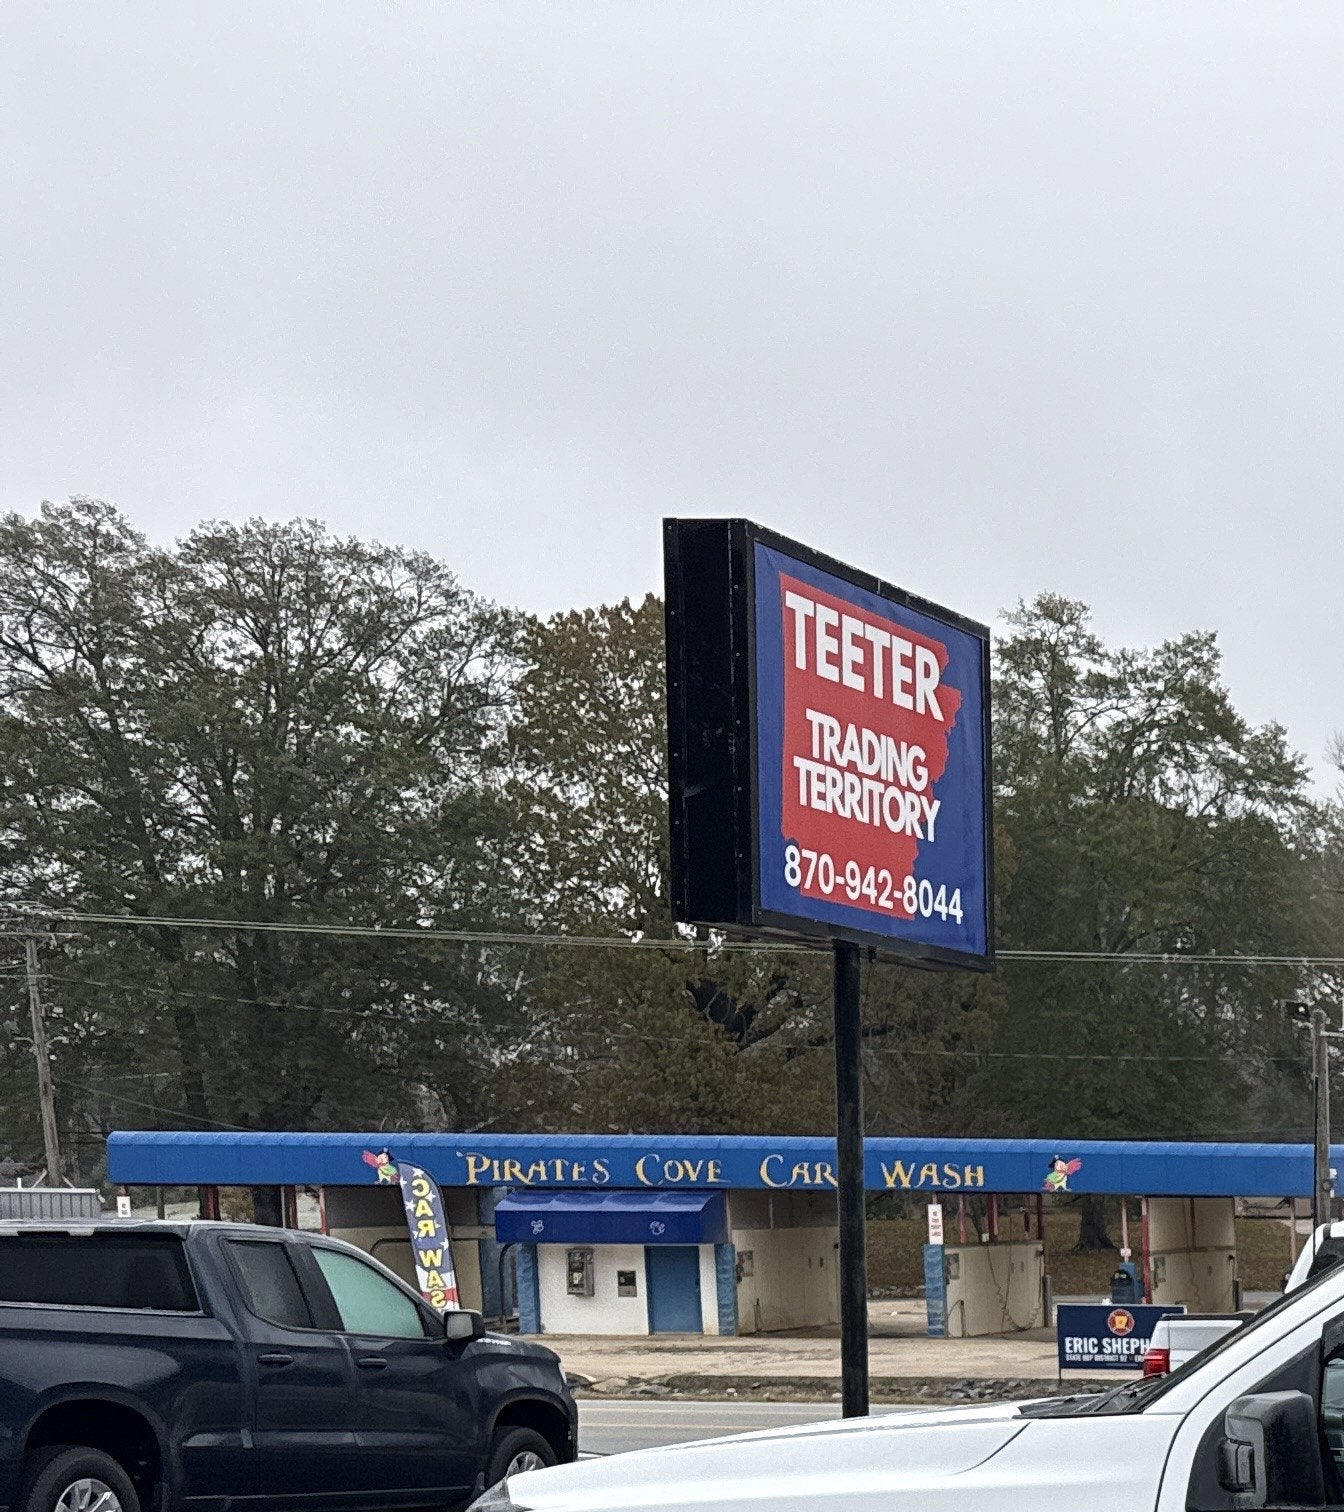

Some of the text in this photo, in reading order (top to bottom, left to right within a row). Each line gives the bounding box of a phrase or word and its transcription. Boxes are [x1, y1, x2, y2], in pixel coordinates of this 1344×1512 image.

[785, 590, 944, 721] TEETER
[806, 708, 928, 791] TRADING
[793, 756, 940, 842] TERRITORY
[784, 844, 963, 924] 870-942-8044
[1065, 1337, 1150, 1354] ERIC SHEPH
